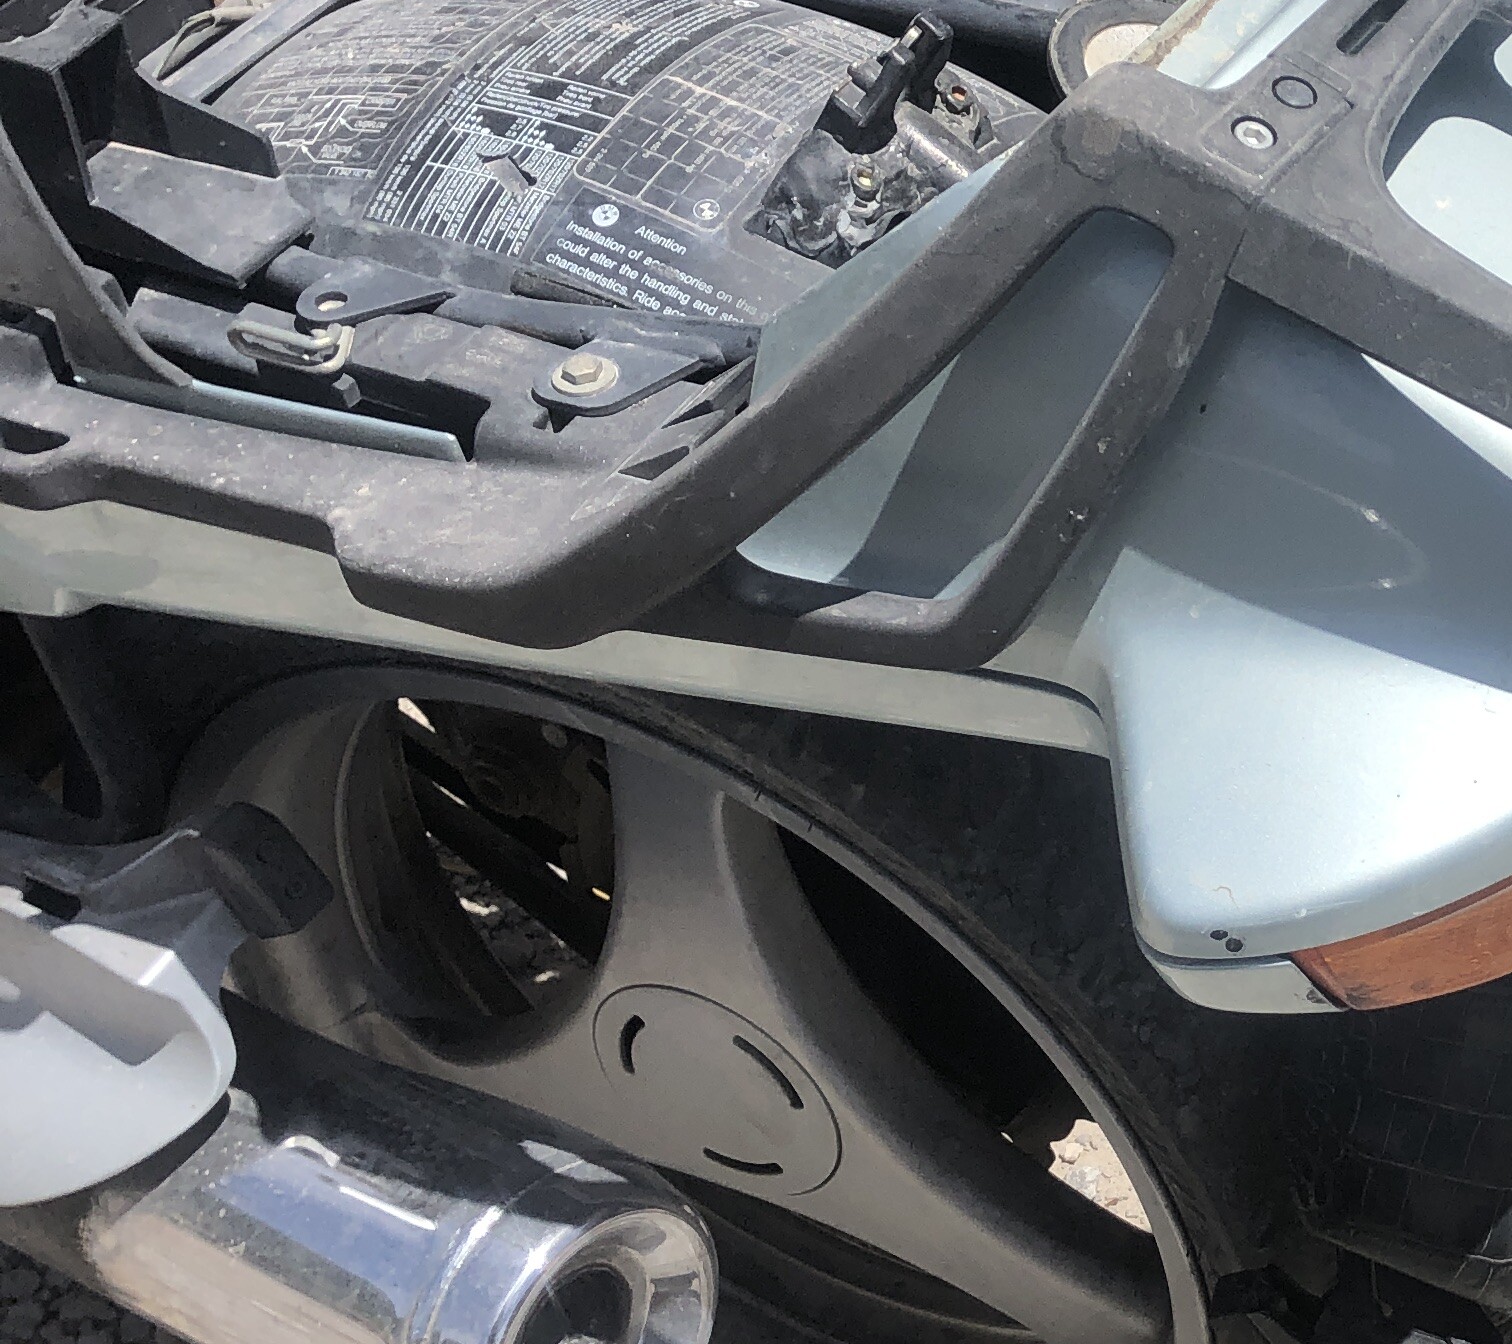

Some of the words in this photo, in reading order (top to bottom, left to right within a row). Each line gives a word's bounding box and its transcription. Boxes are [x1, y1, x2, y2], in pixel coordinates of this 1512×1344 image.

[565, 220, 626, 254] Installation
[628, 250, 644, 261] of
[716, 290, 733, 303] on
[735, 297, 758, 316] this
[634, 225, 687, 255] Attention
[546, 253, 628, 297] characteristics.
[632, 289, 661, 311] Ride
[556, 238, 590, 258] could
[589, 252, 618, 269] alter
[618, 263, 639, 280] the
[641, 272, 691, 305] handling
[692, 299, 719, 317] and
